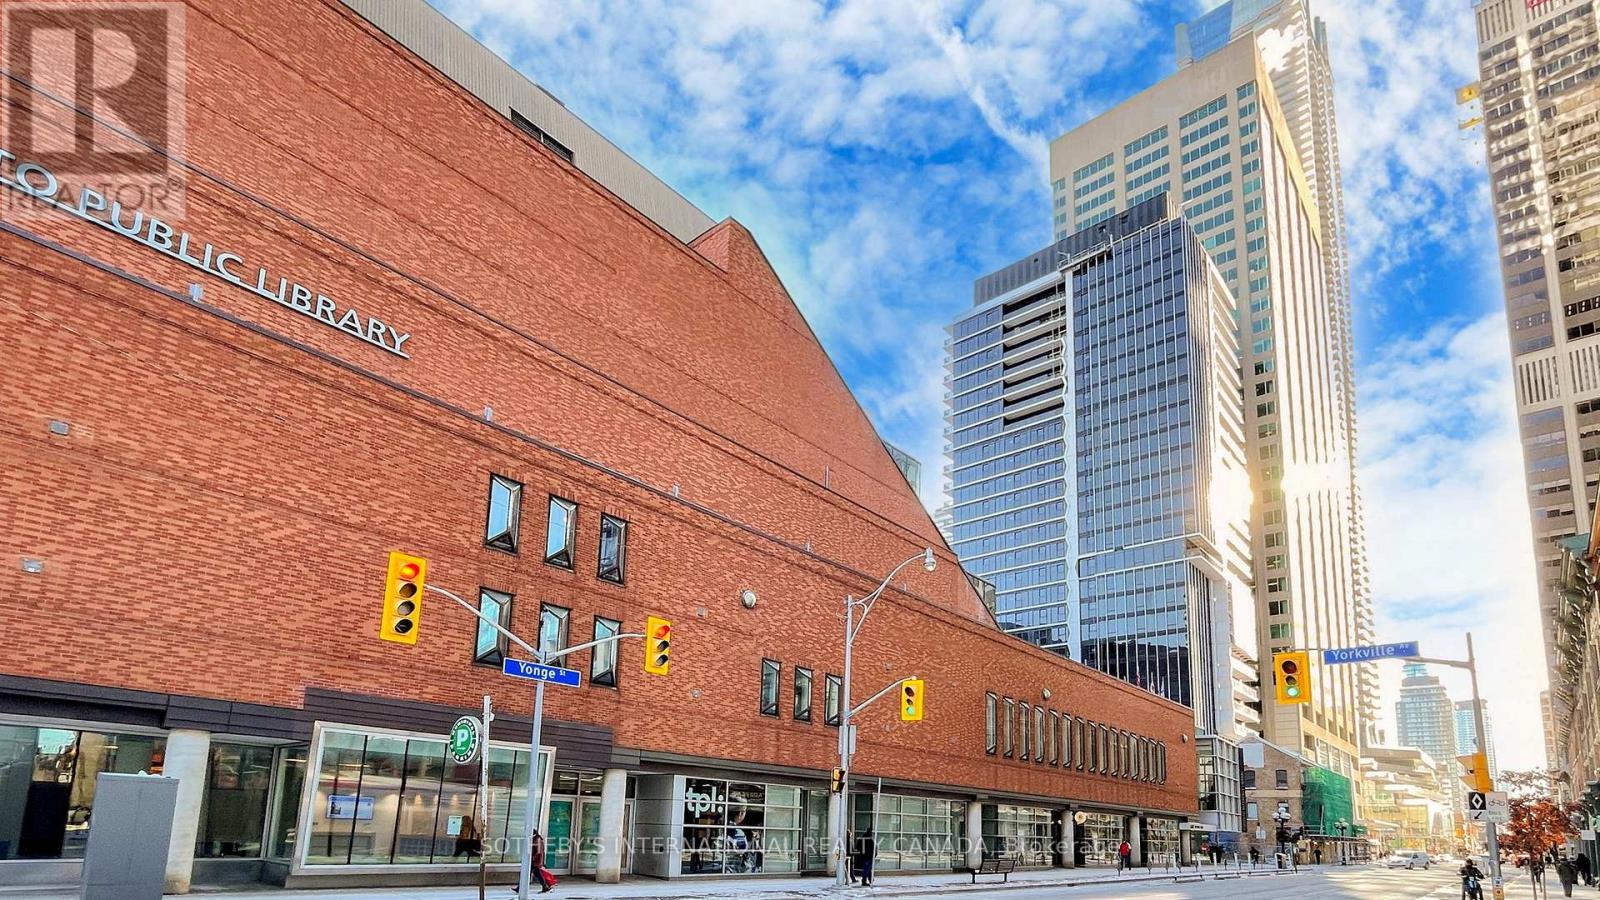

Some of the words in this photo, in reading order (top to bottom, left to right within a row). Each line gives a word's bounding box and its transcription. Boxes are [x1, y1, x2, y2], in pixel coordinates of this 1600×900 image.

[79, 187, 243, 282] PUBLIC
[256, 267, 410, 352] LIBRARY
[1331, 646, 1394, 661] Yorkville
[519, 662, 556, 679] Yonge
[456, 729, 469, 747] P
